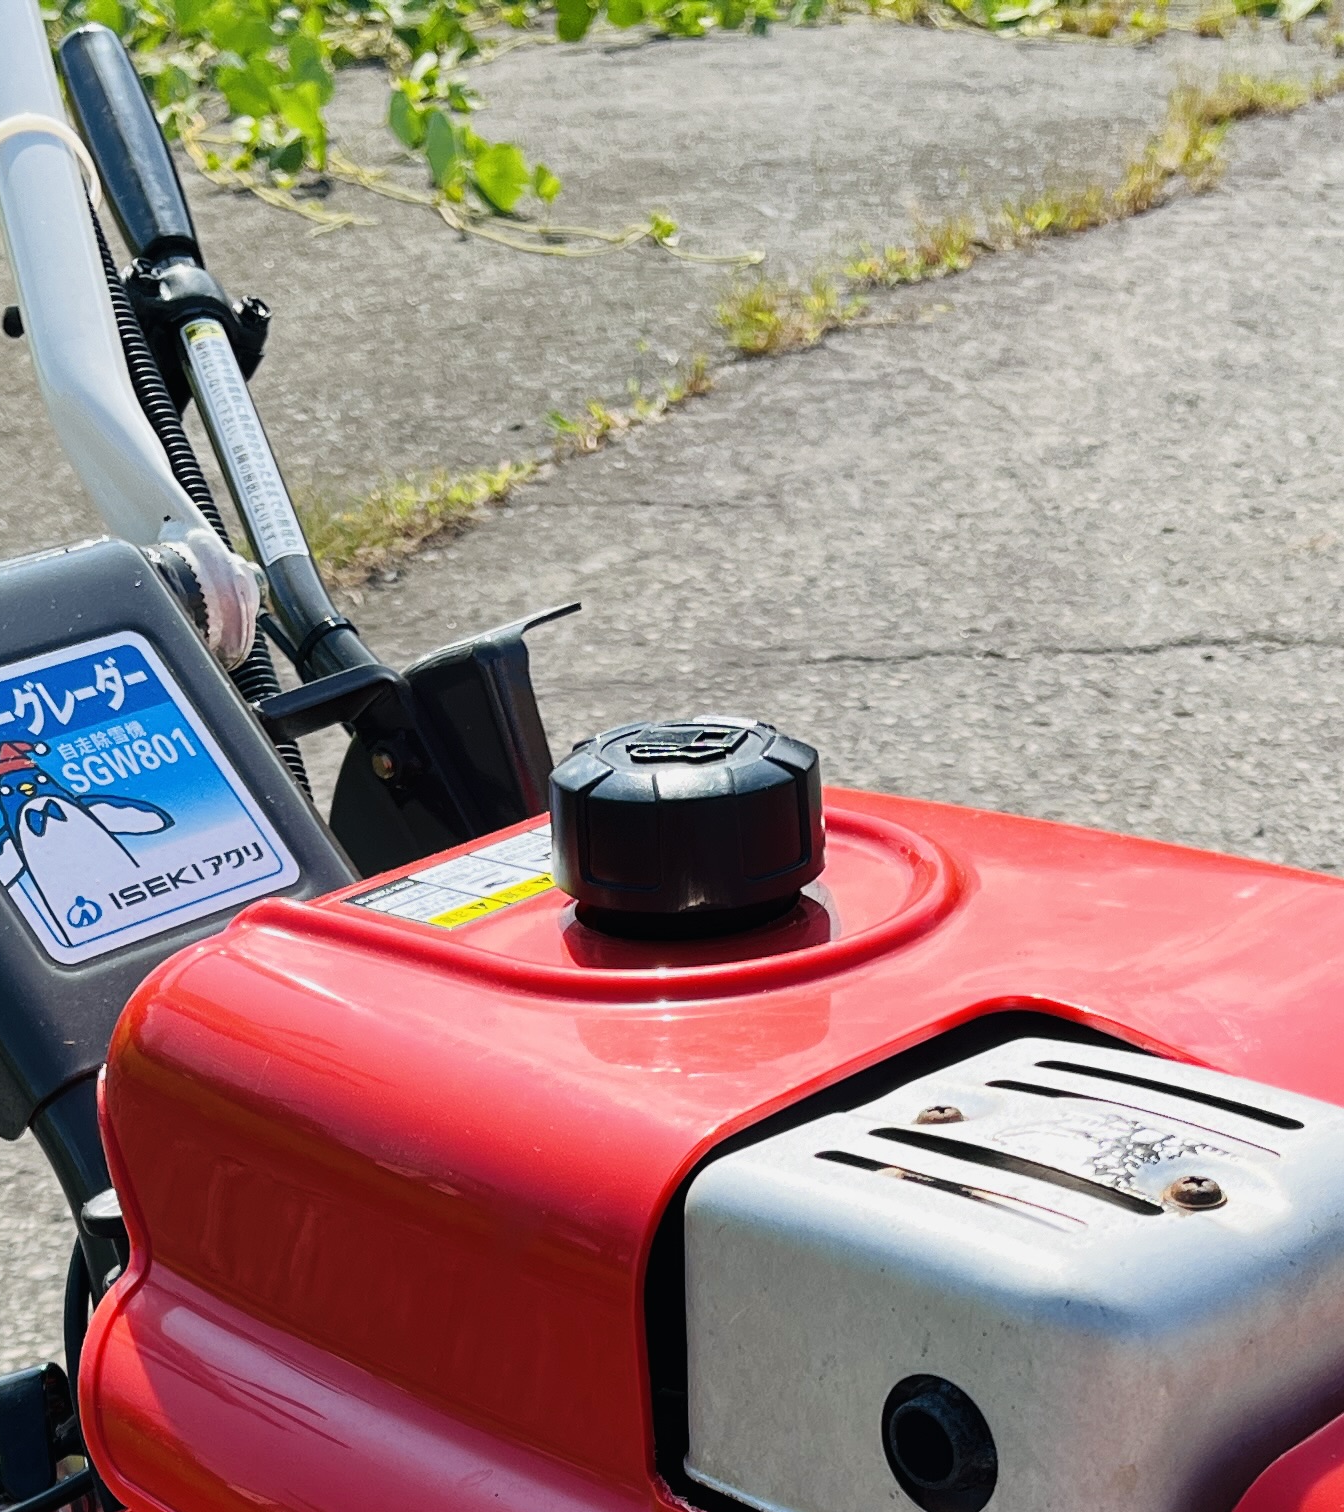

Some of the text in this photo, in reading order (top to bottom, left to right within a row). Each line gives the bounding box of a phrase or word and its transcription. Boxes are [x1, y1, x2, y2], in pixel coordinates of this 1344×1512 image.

[57, 720, 147, 761] 自走除雪機
[61, 728, 197, 794] SGW801
